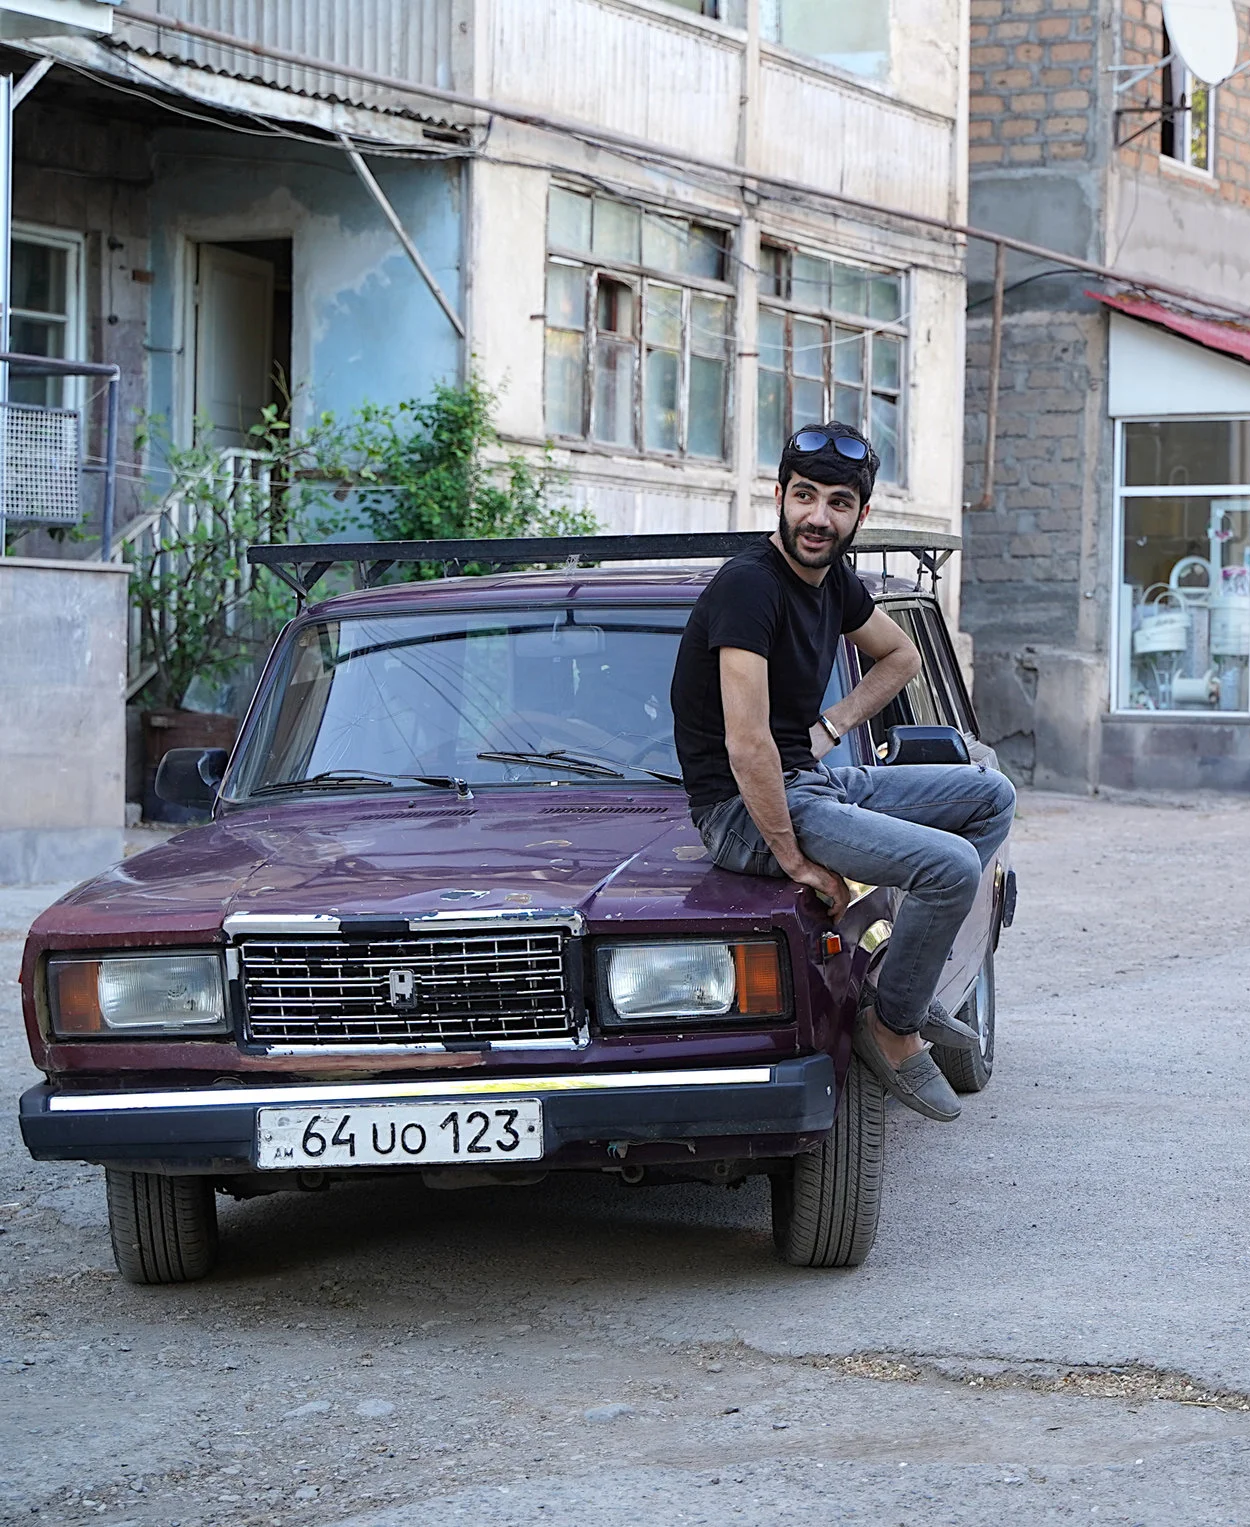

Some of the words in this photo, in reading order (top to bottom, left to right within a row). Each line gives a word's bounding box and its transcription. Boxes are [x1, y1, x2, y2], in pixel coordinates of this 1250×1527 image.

[301, 1115, 355, 1157] 64
[372, 1122, 427, 1155] UO
[439, 1109, 520, 1153] 123
[274, 1147, 295, 1160] AM
